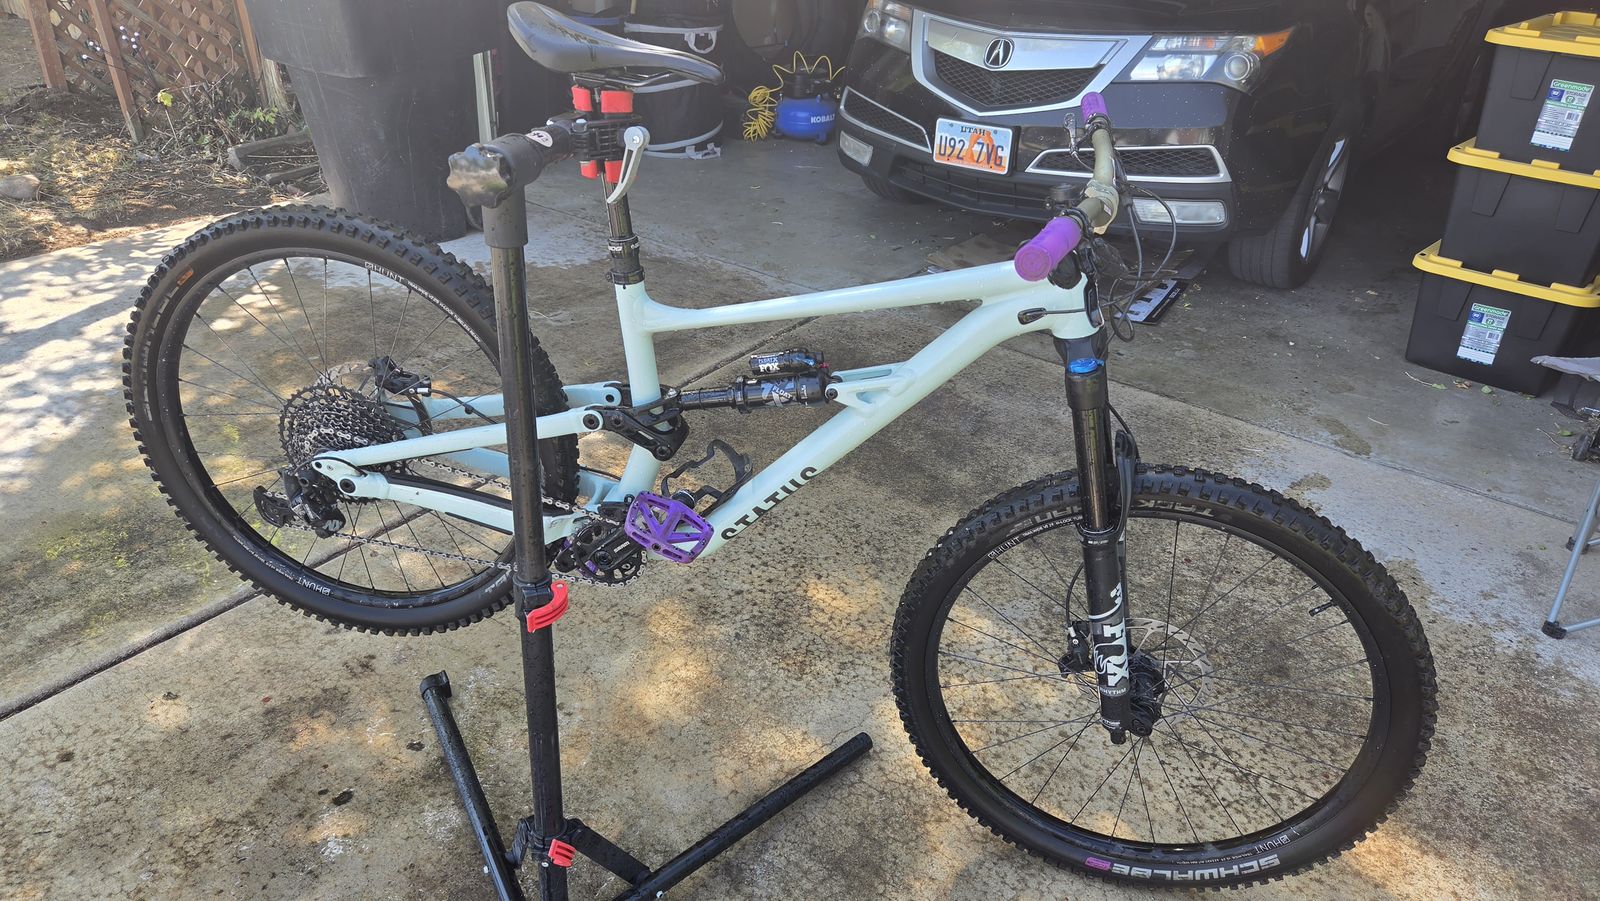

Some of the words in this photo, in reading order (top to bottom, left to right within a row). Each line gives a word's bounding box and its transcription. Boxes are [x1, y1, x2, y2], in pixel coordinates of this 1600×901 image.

[960, 125, 986, 137] UTAH
[938, 134, 966, 161] U92
[975, 140, 1005, 167] 7VG
[374, 265, 405, 283] HUNT
[759, 362, 781, 373] FOX
[772, 385, 793, 399] FLOAT
[995, 537, 1020, 557] HUNT
[296, 577, 323, 592] HUNT
[1094, 617, 1129, 687] FOX
[1254, 836, 1283, 855] HUNT
[1111, 854, 1281, 881] SCHWALBE
